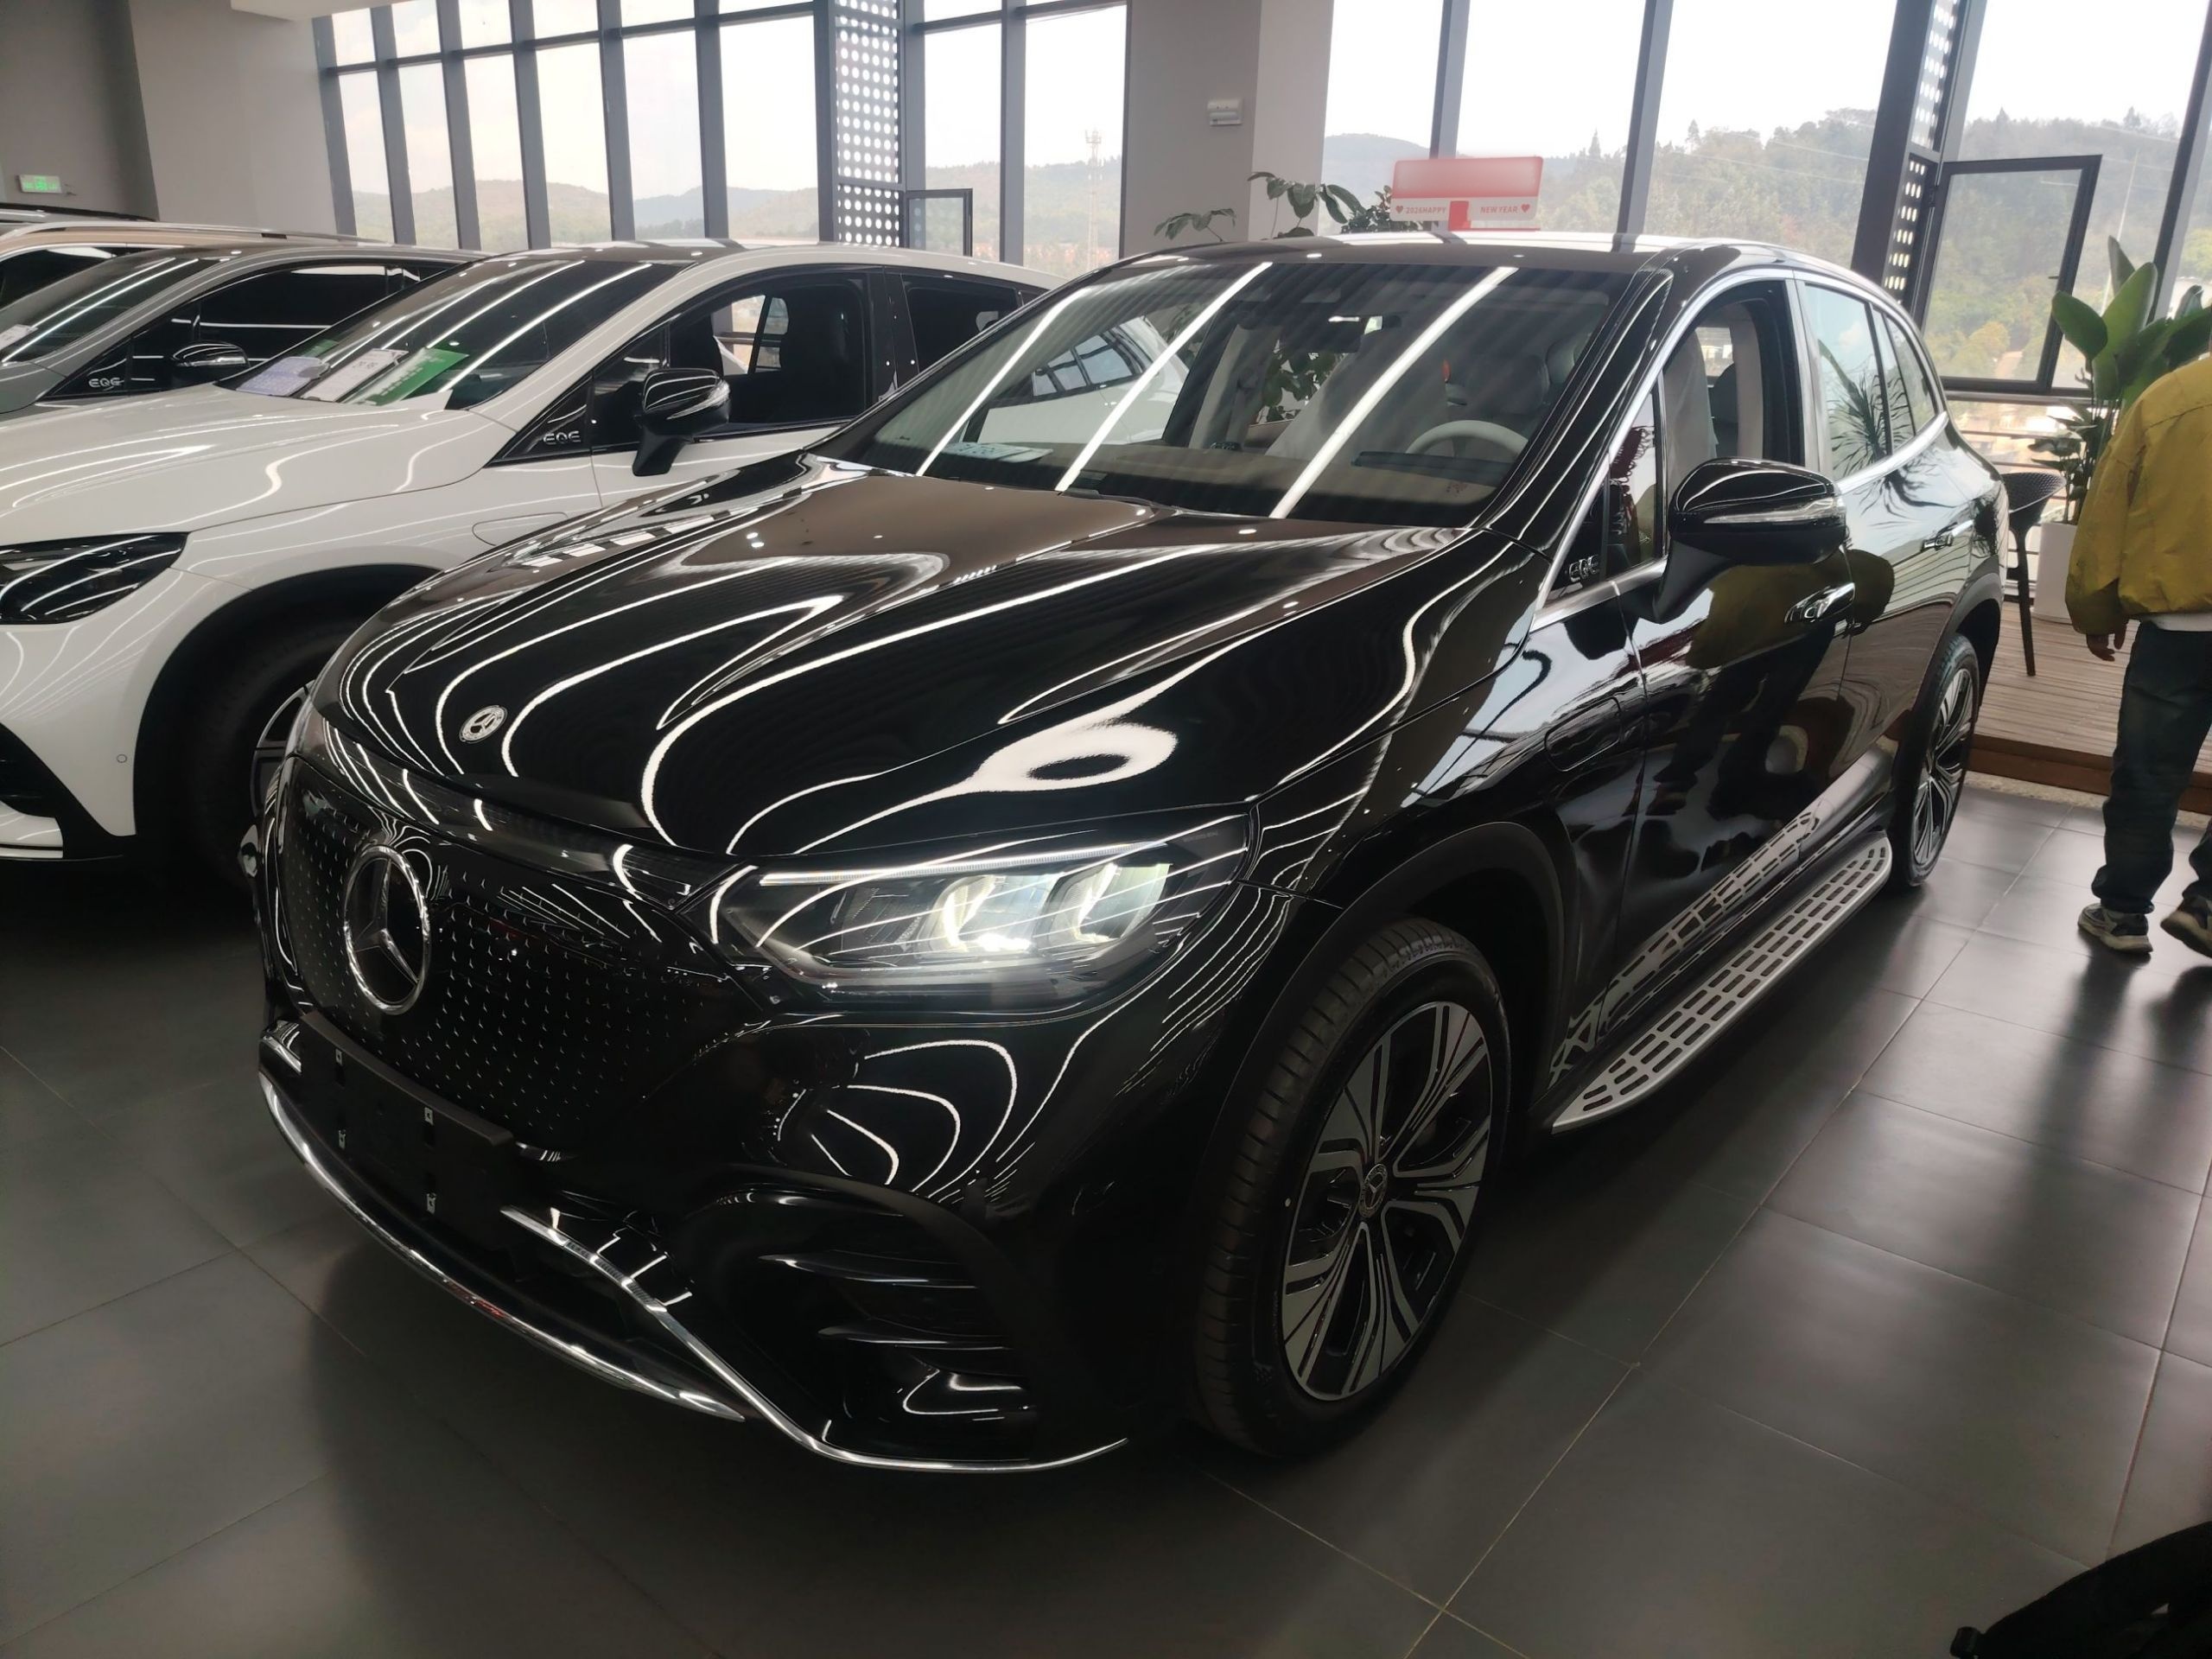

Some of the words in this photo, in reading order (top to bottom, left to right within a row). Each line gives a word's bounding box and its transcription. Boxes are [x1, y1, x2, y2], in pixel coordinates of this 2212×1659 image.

[1480, 206, 1498, 214] NEW
[1499, 205, 1518, 213] YEAR
[543, 430, 582, 445] EQE
